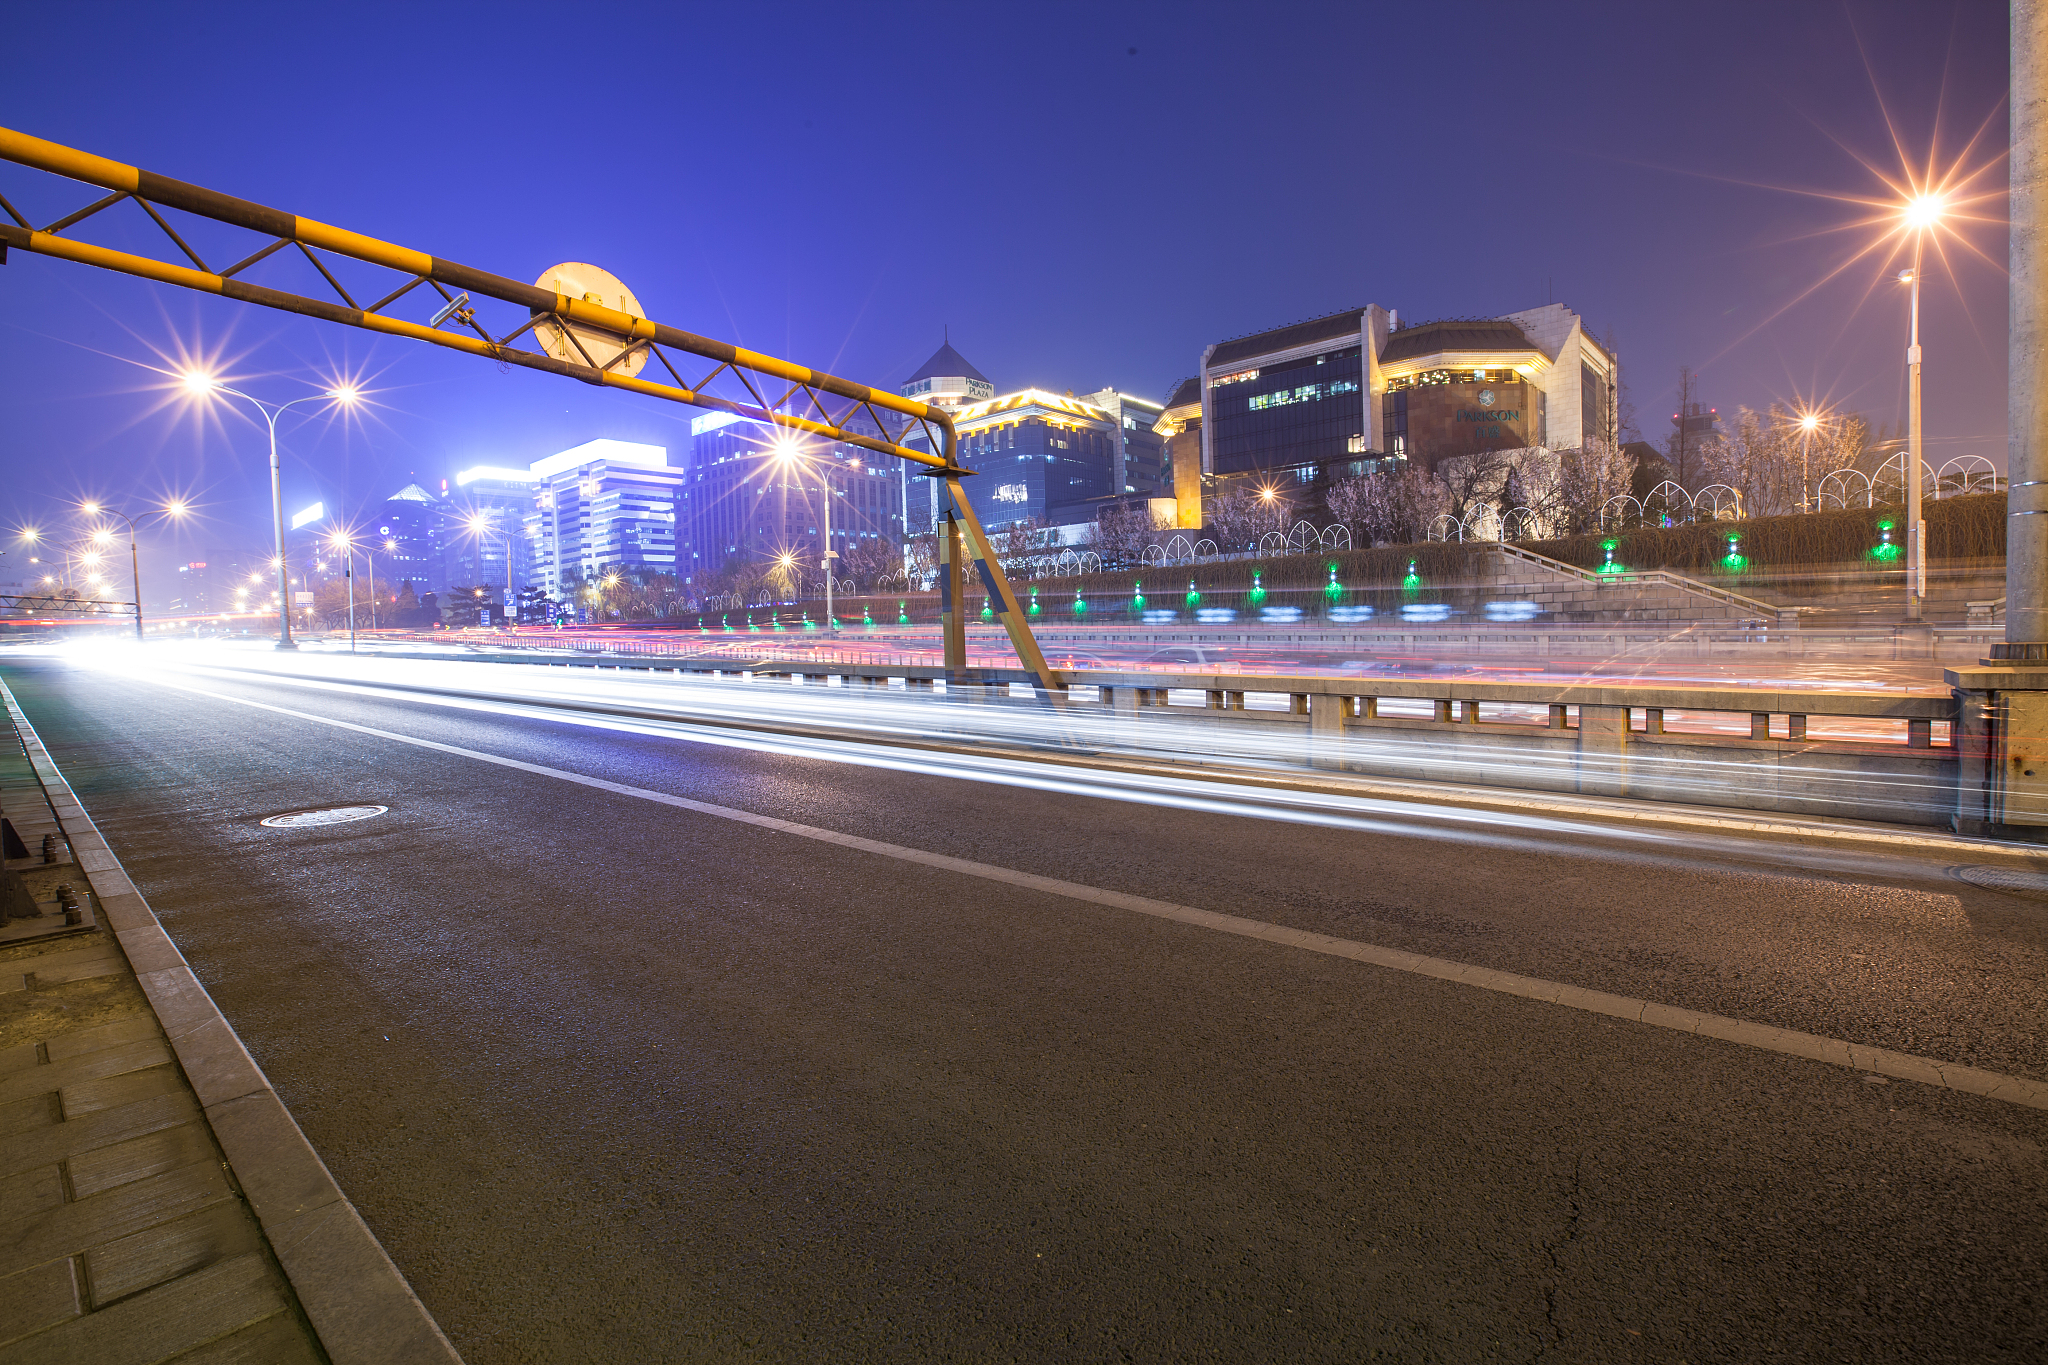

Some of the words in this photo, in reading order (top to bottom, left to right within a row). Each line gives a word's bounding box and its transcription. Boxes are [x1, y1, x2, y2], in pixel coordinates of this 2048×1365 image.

[968, 386, 989, 398] PLAZA
[1457, 409, 1519, 422] PARKSON
[1475, 425, 1501, 438] 百盛
